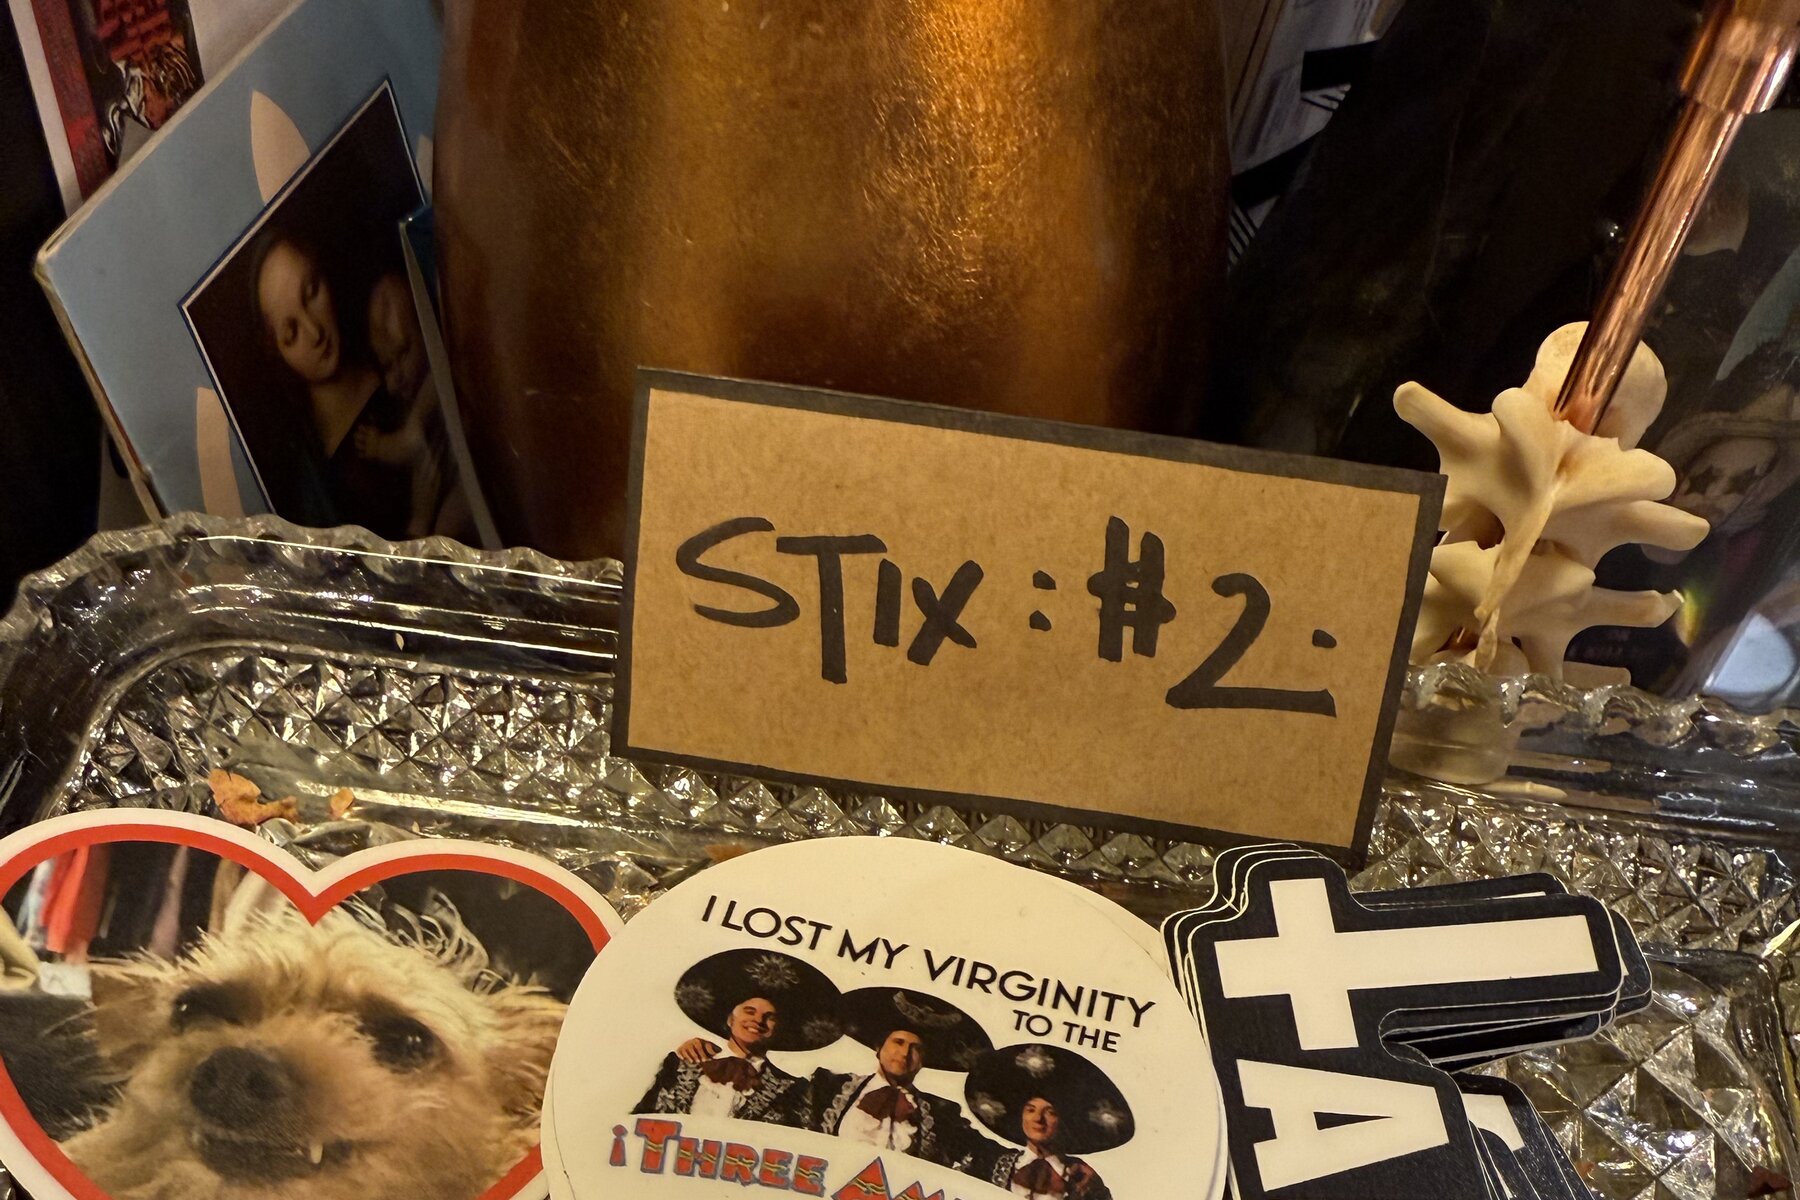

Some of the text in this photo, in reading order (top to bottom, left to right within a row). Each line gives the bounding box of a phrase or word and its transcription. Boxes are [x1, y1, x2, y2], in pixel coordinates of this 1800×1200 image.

[700, 894, 1157, 1028] I LOST MY VIRGINITY
[1012, 1008, 1122, 1054] TO THE
